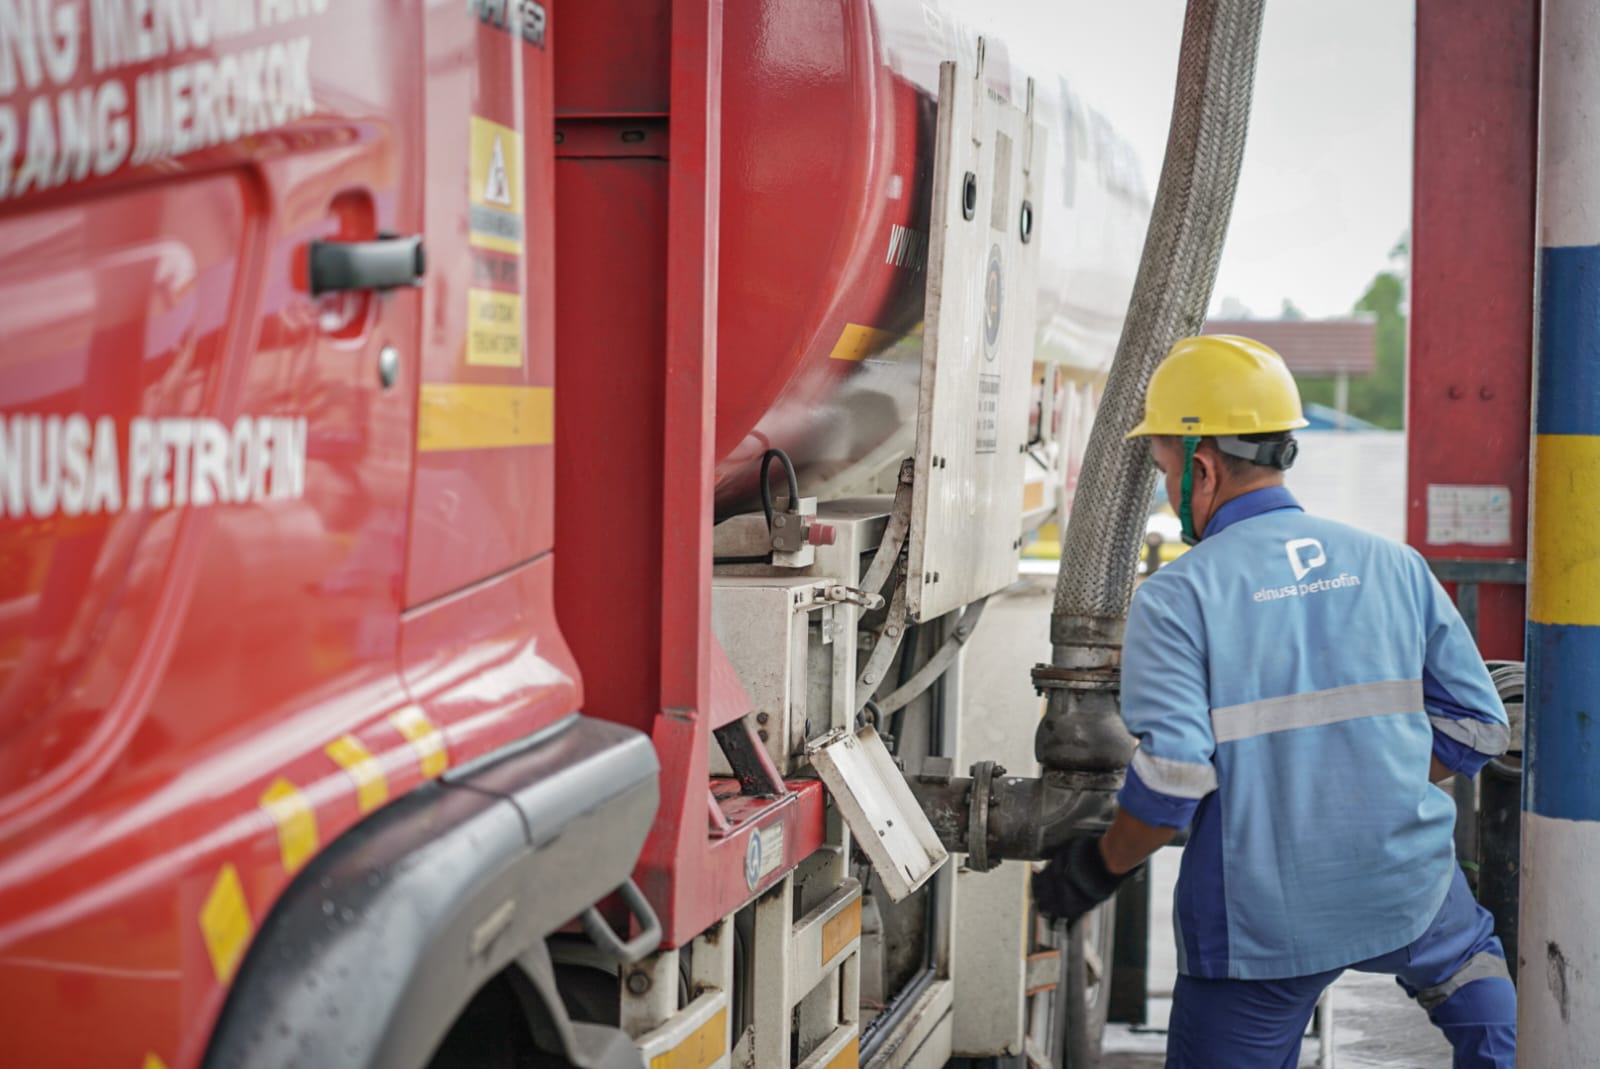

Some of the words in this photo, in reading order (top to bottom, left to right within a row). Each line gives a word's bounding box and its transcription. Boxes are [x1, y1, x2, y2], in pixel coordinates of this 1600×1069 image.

[130, 35, 316, 168] MEROKOK
[128, 414, 307, 511] PETROFIN
[1253, 584, 1297, 602] elnusa
[1298, 572, 1361, 597] petrofin
